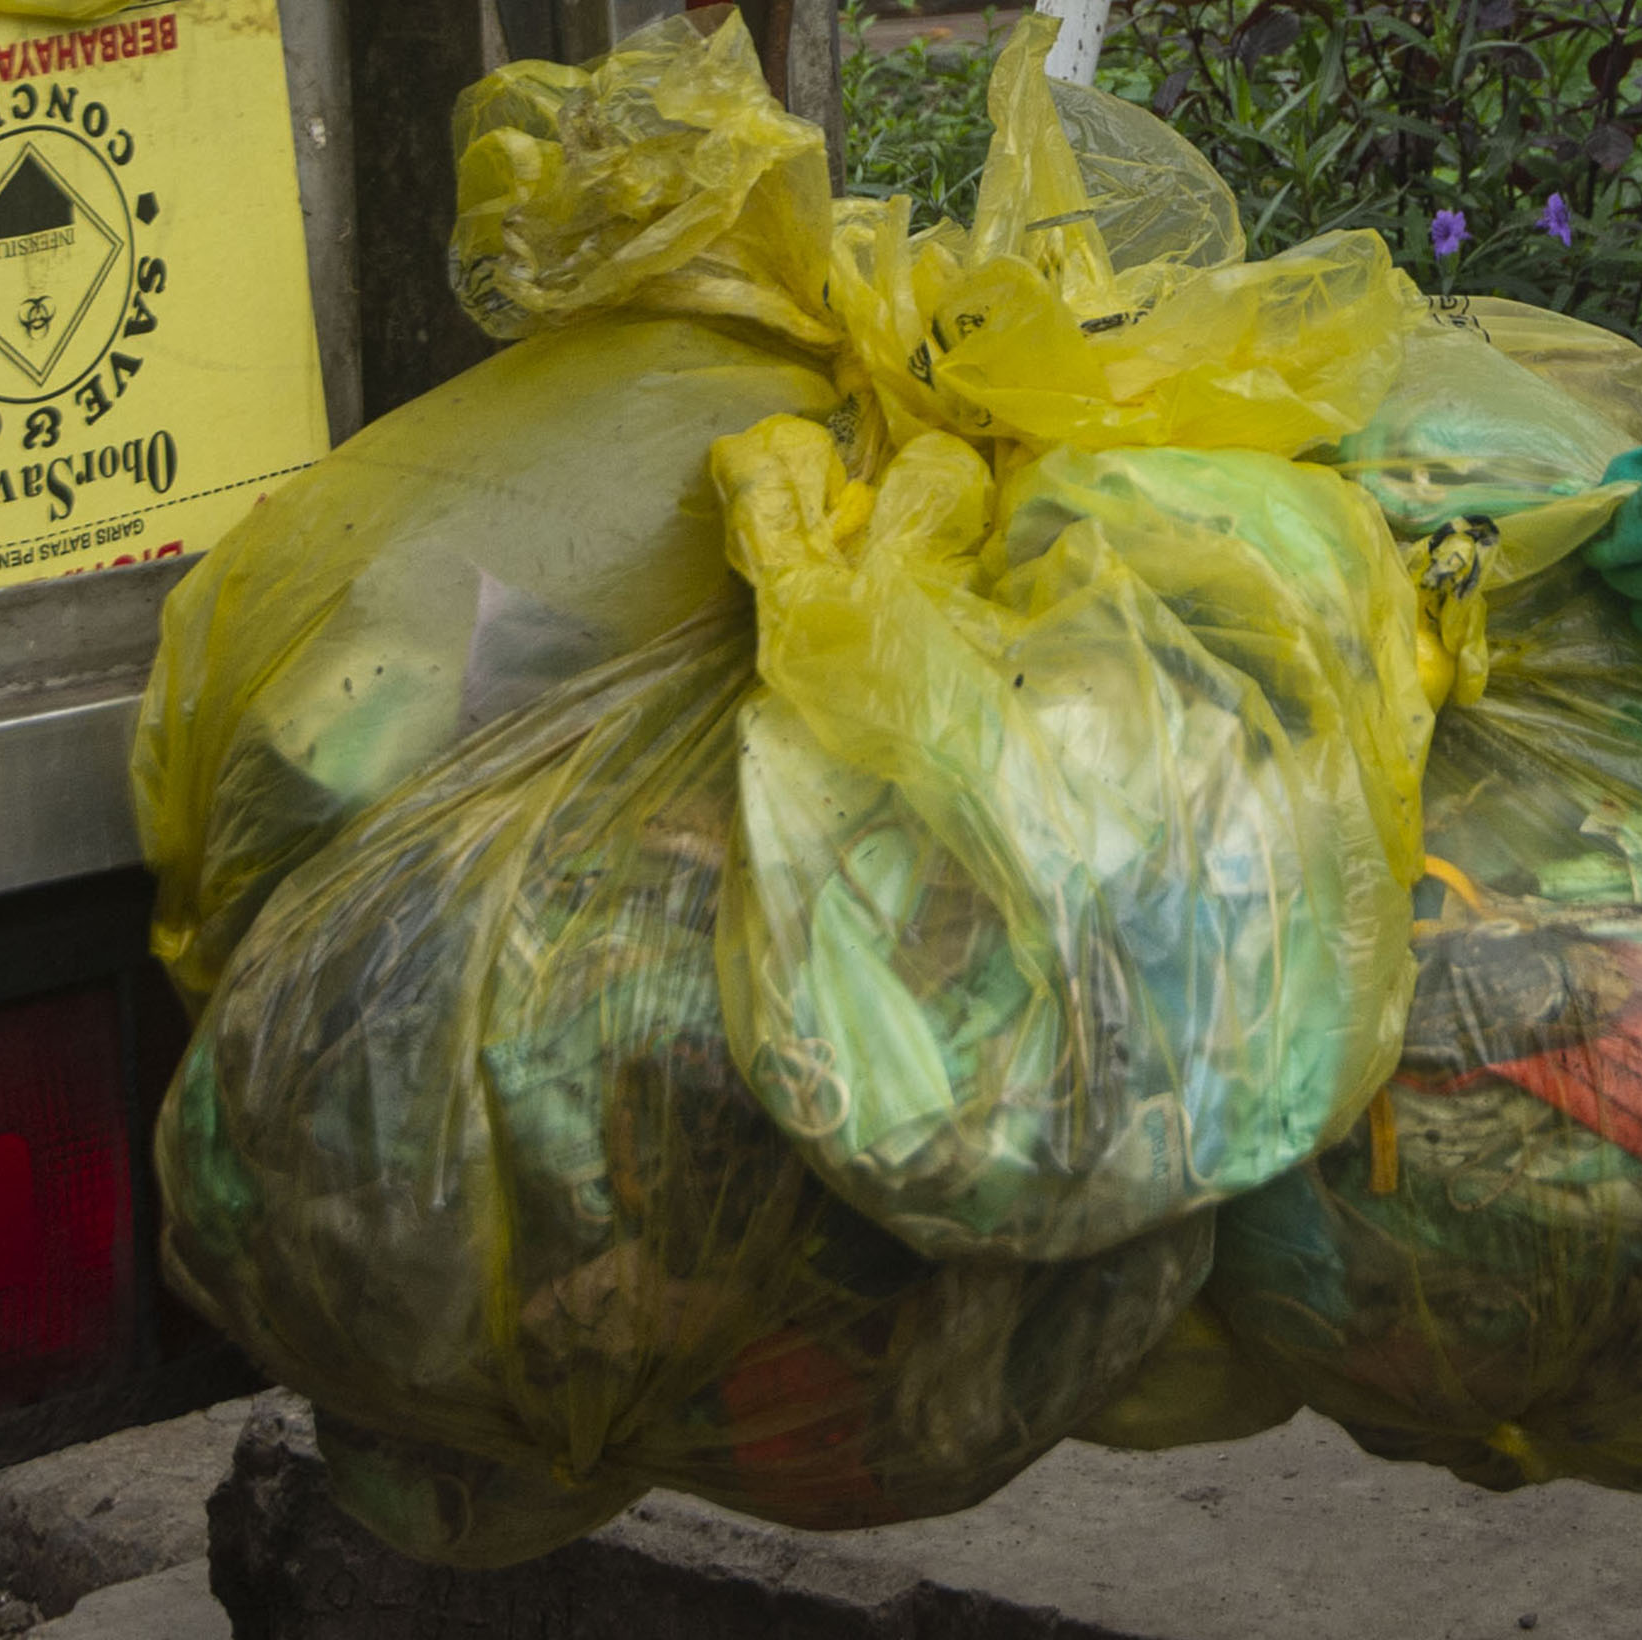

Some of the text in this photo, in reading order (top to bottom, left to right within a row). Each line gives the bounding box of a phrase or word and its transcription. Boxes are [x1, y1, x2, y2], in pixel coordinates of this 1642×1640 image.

[75, 256, 168, 426] SAVE
[23, 406, 63, 449] &
[39, 536, 92, 559] BATAS
[96, 517, 145, 547] GARIS
